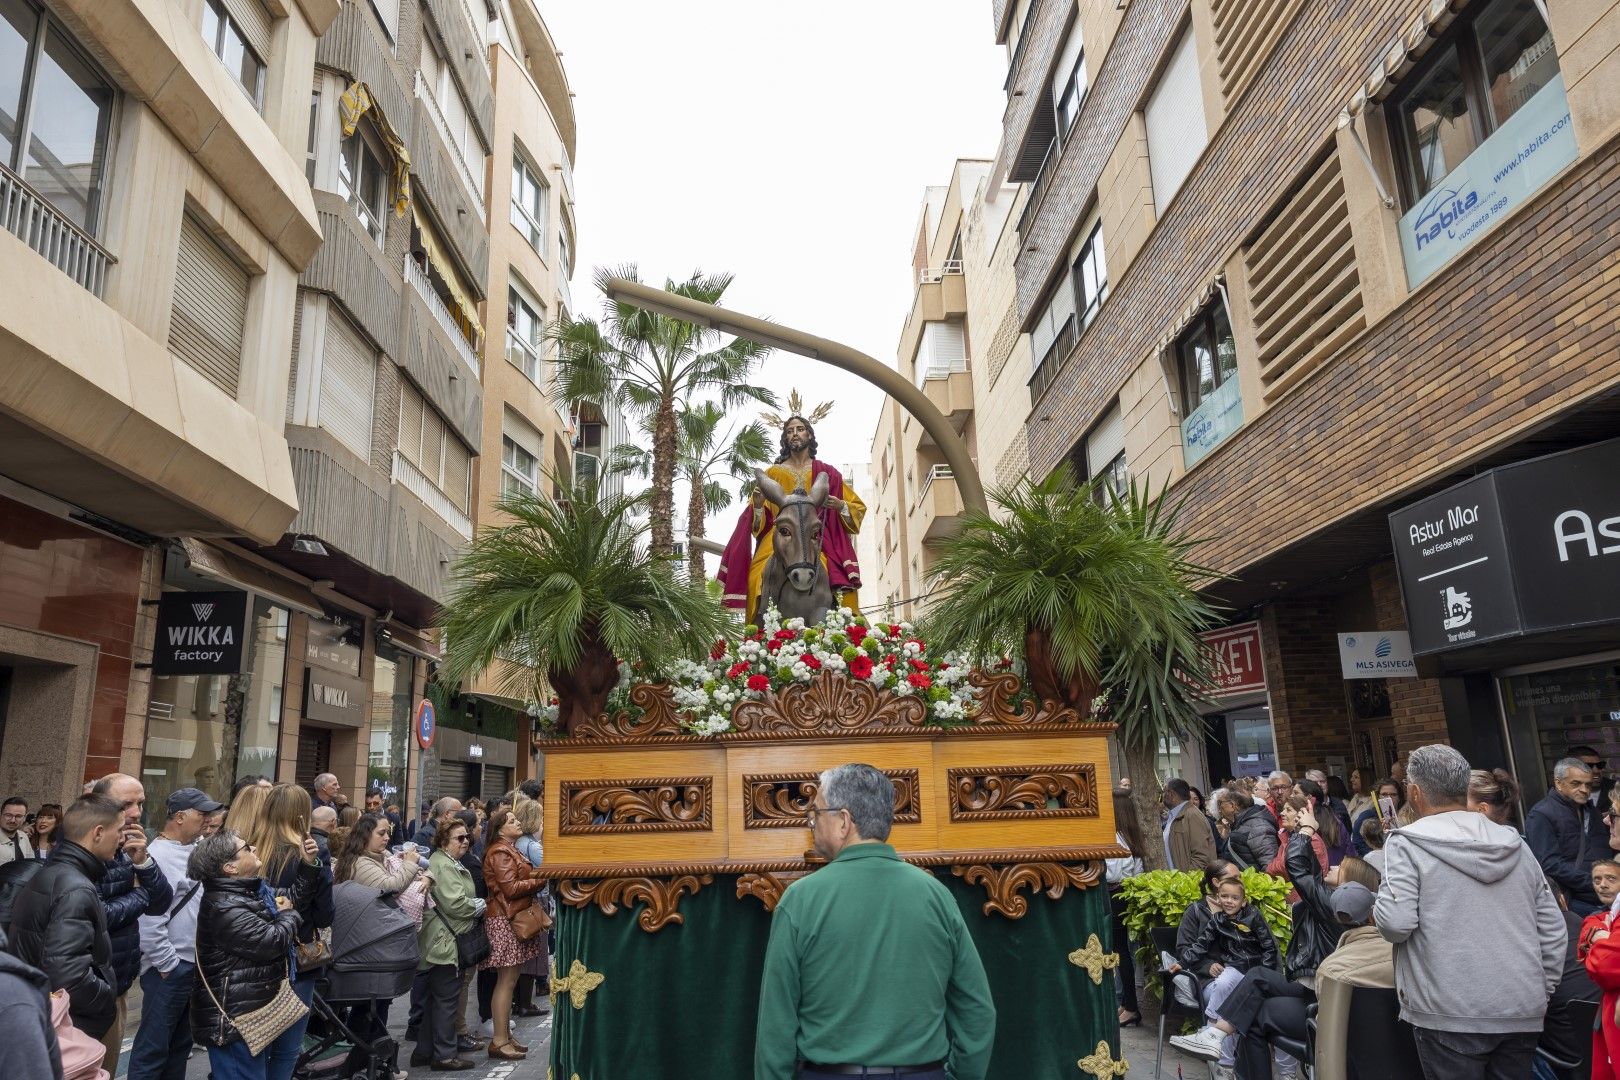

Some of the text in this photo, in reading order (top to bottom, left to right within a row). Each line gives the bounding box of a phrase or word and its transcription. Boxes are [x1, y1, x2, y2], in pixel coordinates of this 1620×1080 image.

[1415, 190, 1478, 251] habita
[1458, 211, 1490, 241] vuodesta
[1490, 196, 1508, 214] 1989
[1409, 505, 1479, 546] Astur Mar
[1422, 533, 1474, 557] Real Estate Agency
[168, 625, 234, 646] WIKKA
[174, 649, 224, 663] factory
[1356, 660, 1414, 669] MLS ASIVEGA
[324, 685, 348, 708] WIKKA
